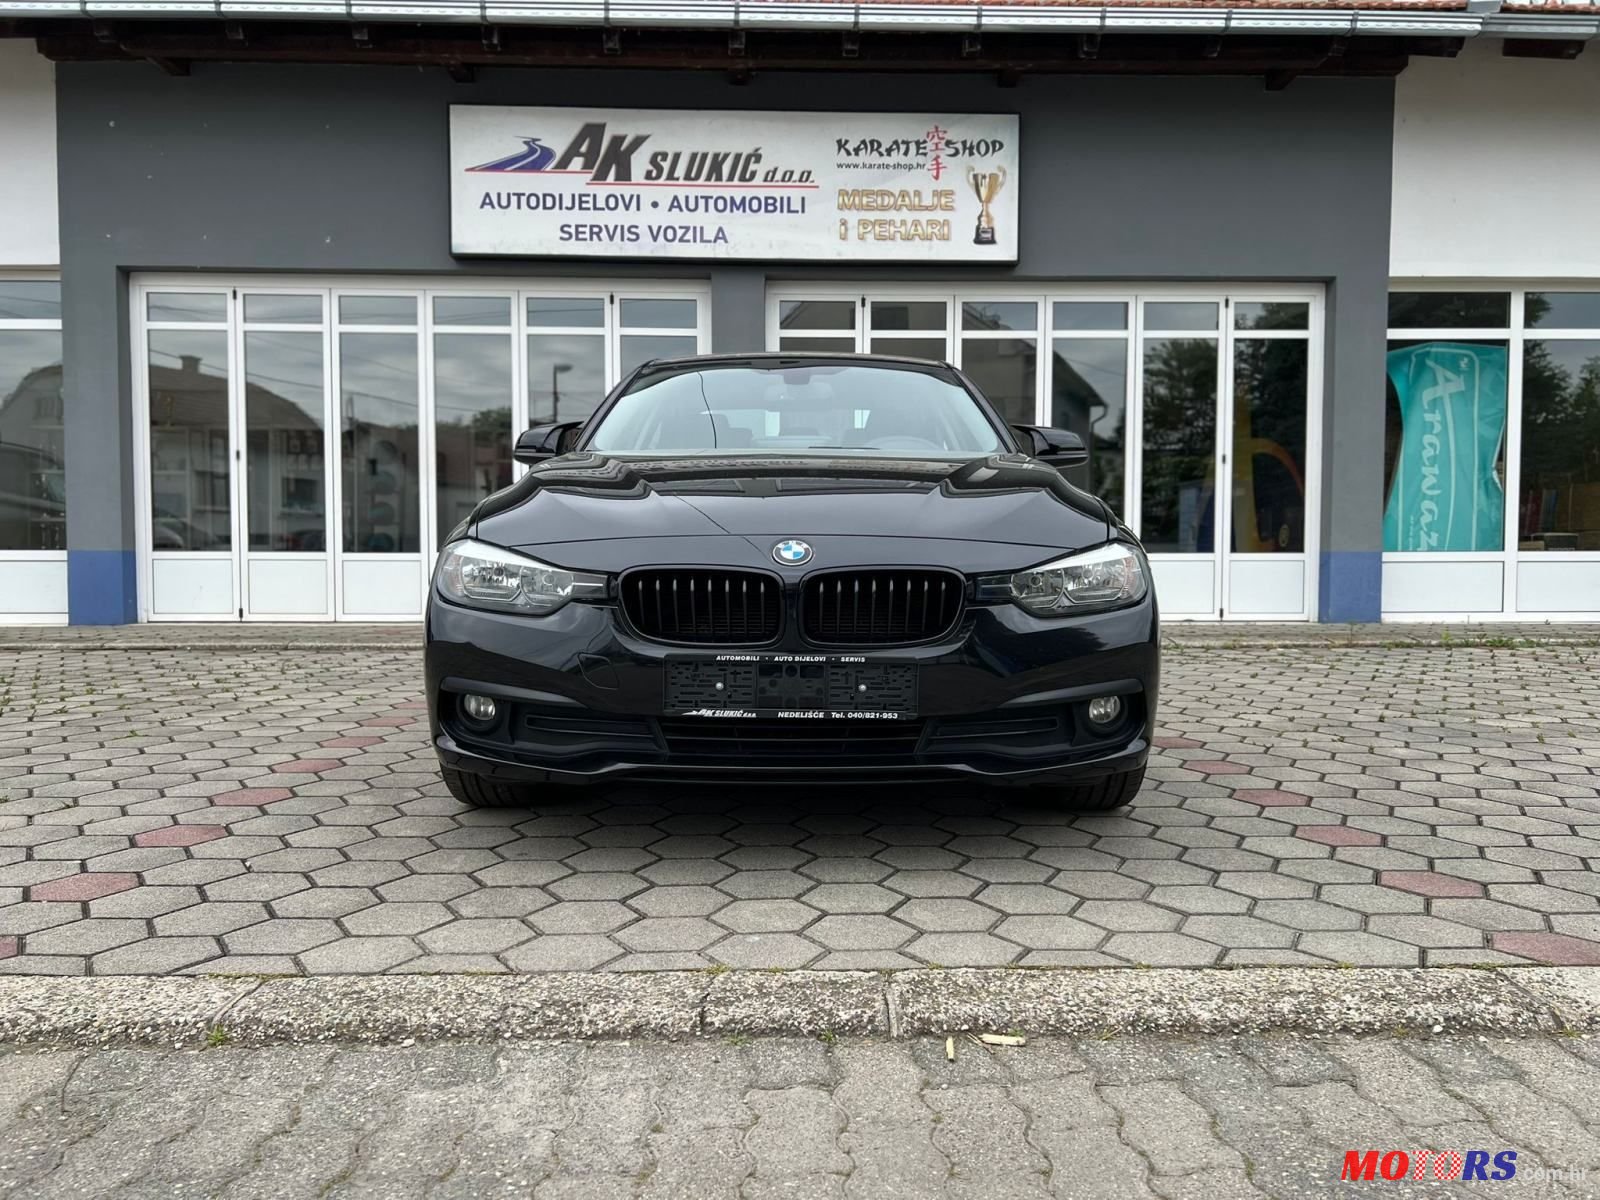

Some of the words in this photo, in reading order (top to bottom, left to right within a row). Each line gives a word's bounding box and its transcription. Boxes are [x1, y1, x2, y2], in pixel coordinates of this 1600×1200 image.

[551, 122, 652, 182] AK
[643, 147, 763, 184] SLUKIĆ
[836, 138, 928, 158] KARATE
[945, 139, 1004, 158] SHOP
[836, 162, 926, 173] www.karate-shop.hr
[480, 192, 641, 212] AUTODIJELOVI
[668, 195, 806, 214] AUTOMOBILI
[836, 188, 955, 213] MEDALJE
[559, 223, 640, 242] SERVIS
[648, 225, 728, 244] VOZILA
[857, 218, 951, 241] PEHARI
[831, 711, 845, 719] Tel.
[847, 711, 898, 719] 040/821-953
